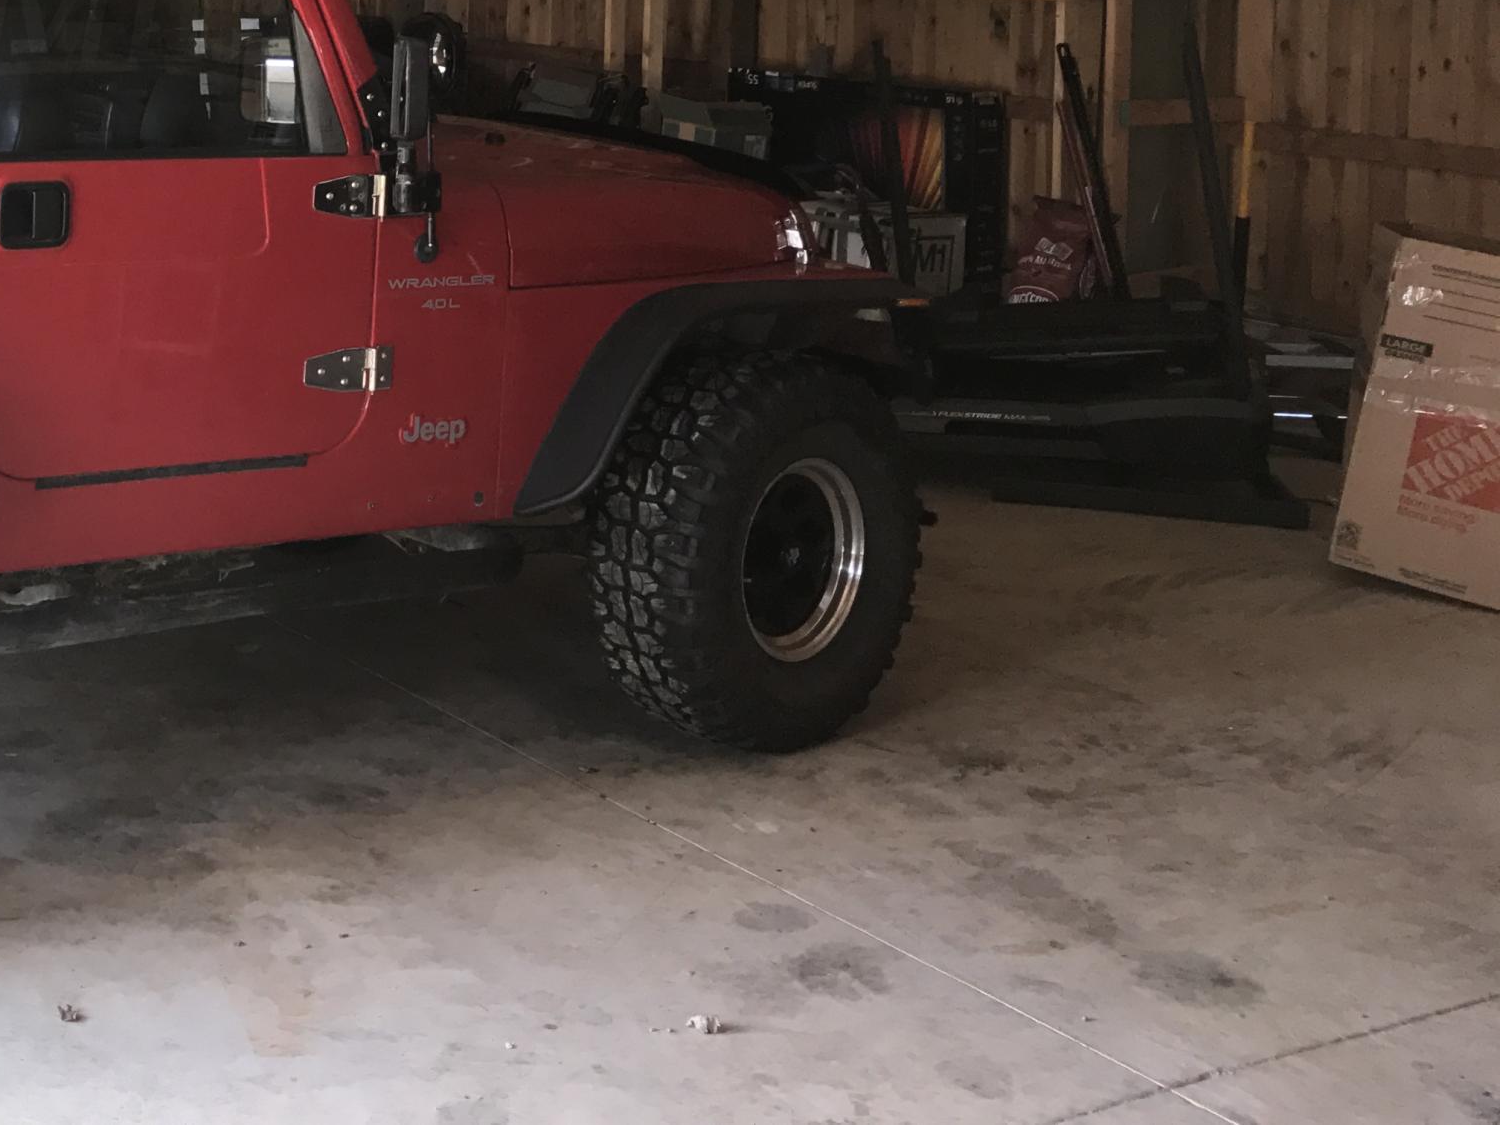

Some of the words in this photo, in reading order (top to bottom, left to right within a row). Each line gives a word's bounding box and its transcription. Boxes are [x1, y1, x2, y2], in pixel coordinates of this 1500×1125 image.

[388, 274, 496, 290] WRANGLER
[1386, 338, 1426, 355] LARGE
[403, 416, 466, 443] Jeep
